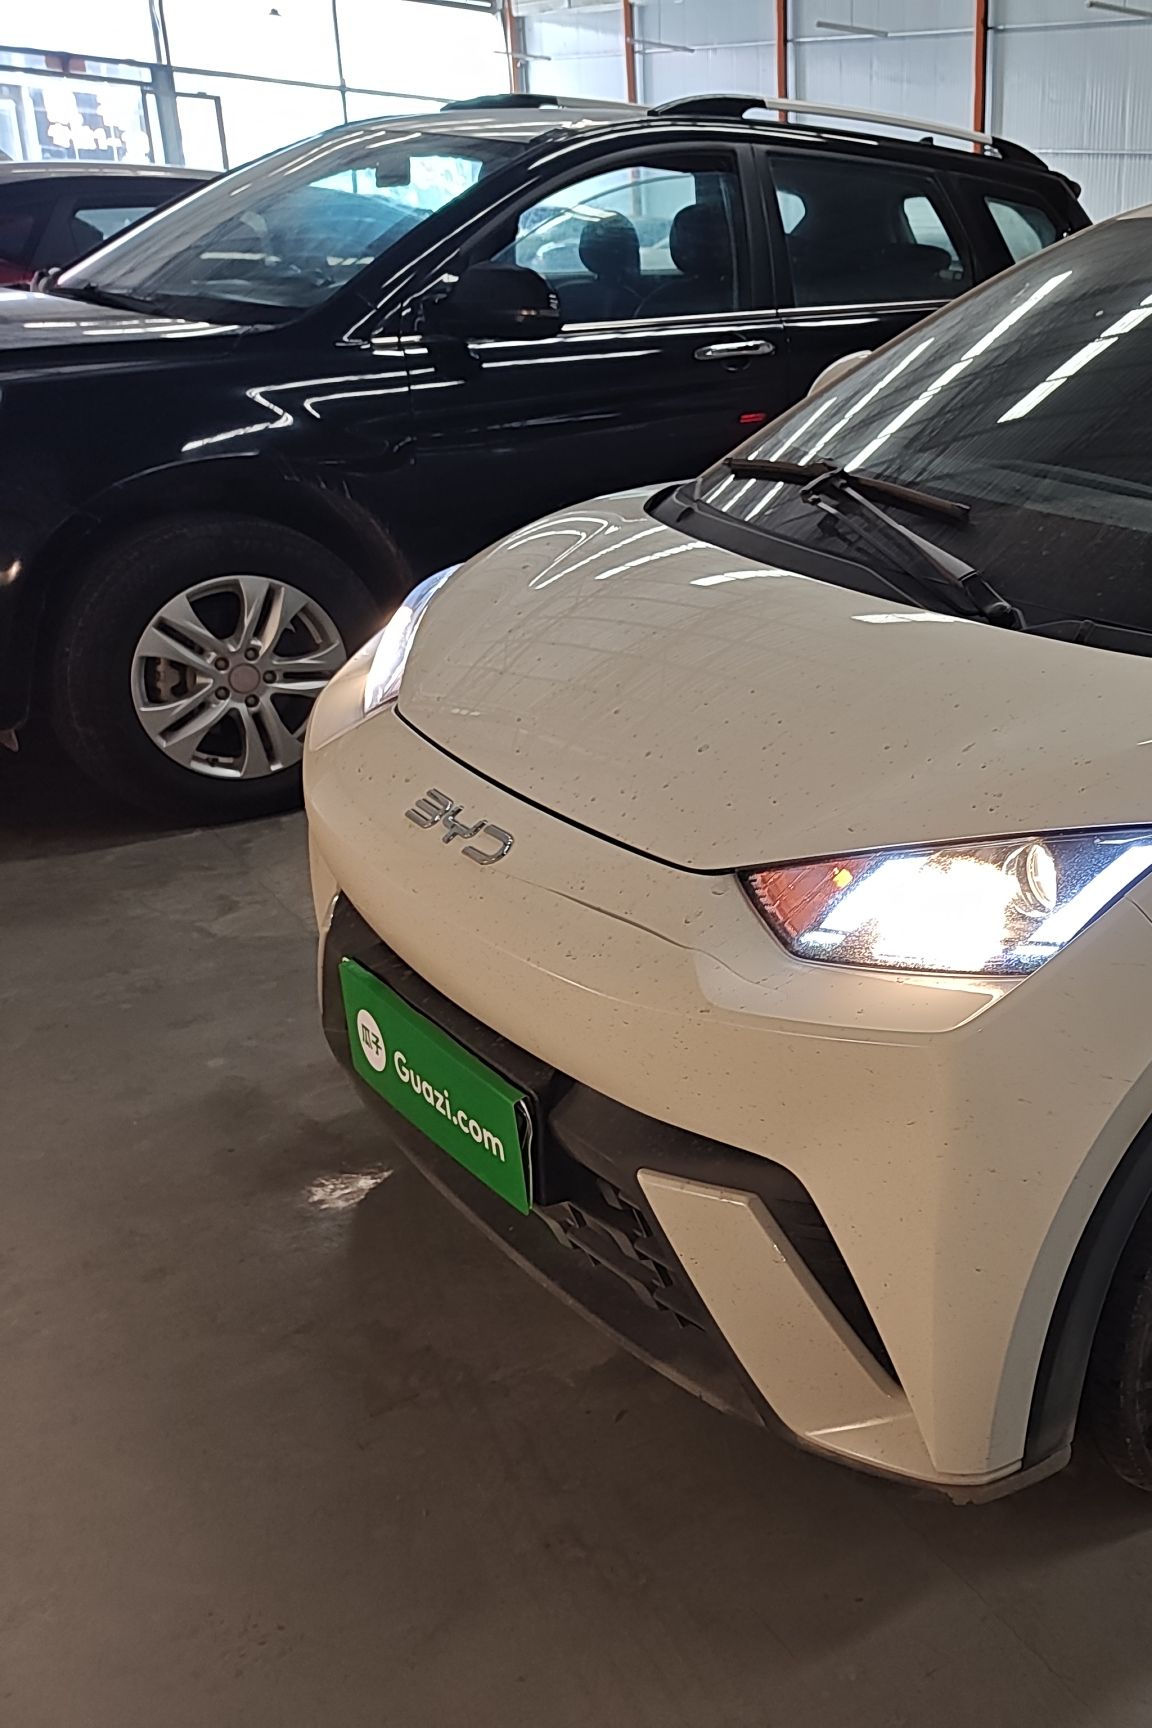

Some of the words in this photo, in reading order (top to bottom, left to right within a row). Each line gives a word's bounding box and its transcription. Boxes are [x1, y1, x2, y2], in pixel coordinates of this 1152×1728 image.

[405, 788, 514, 865] BYD
[361, 1023, 383, 1056] 瓜子
[394, 1051, 505, 1162] Guazi.com
